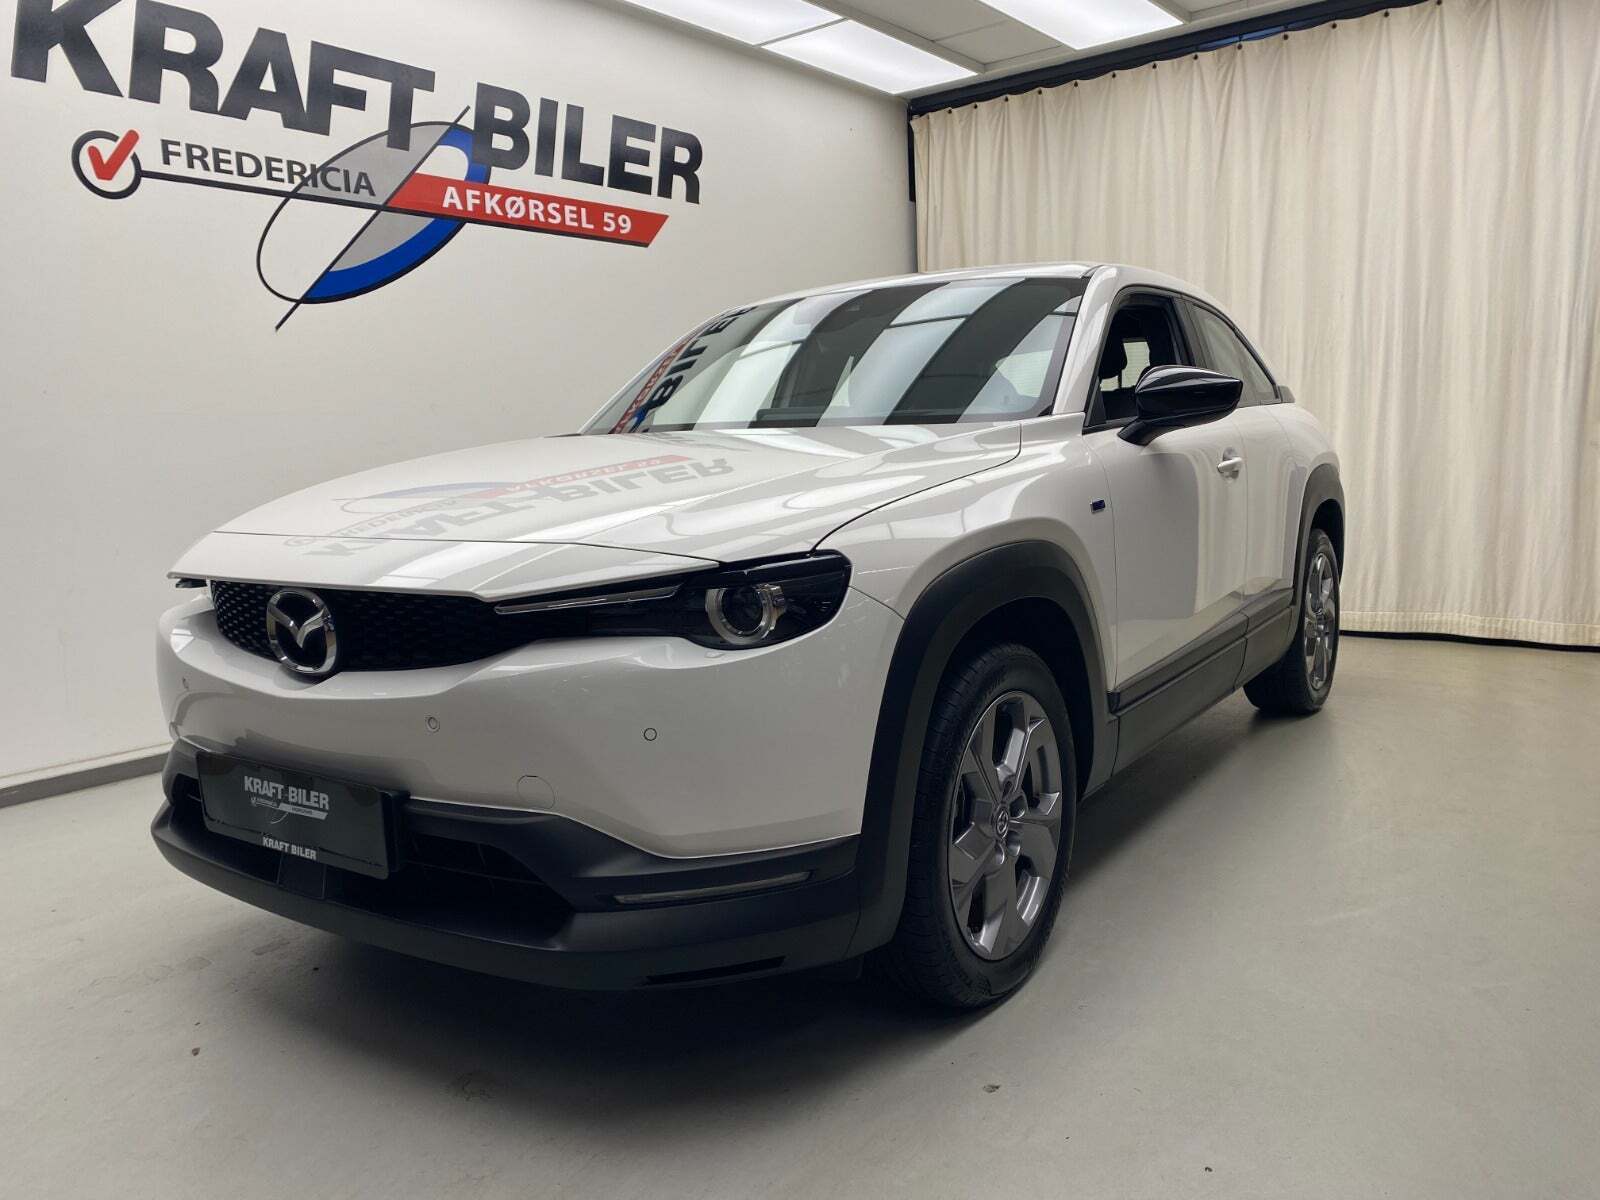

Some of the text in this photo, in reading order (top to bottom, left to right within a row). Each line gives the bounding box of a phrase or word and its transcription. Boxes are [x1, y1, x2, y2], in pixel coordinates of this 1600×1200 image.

[11, 0, 703, 205] KRAFT BILER
[160, 139, 376, 197] FREDERICIA
[442, 186, 632, 234] AFKØRSEL 59
[244, 776, 329, 810] KRAFT BILER
[262, 836, 317, 861] KRAFT BILER
